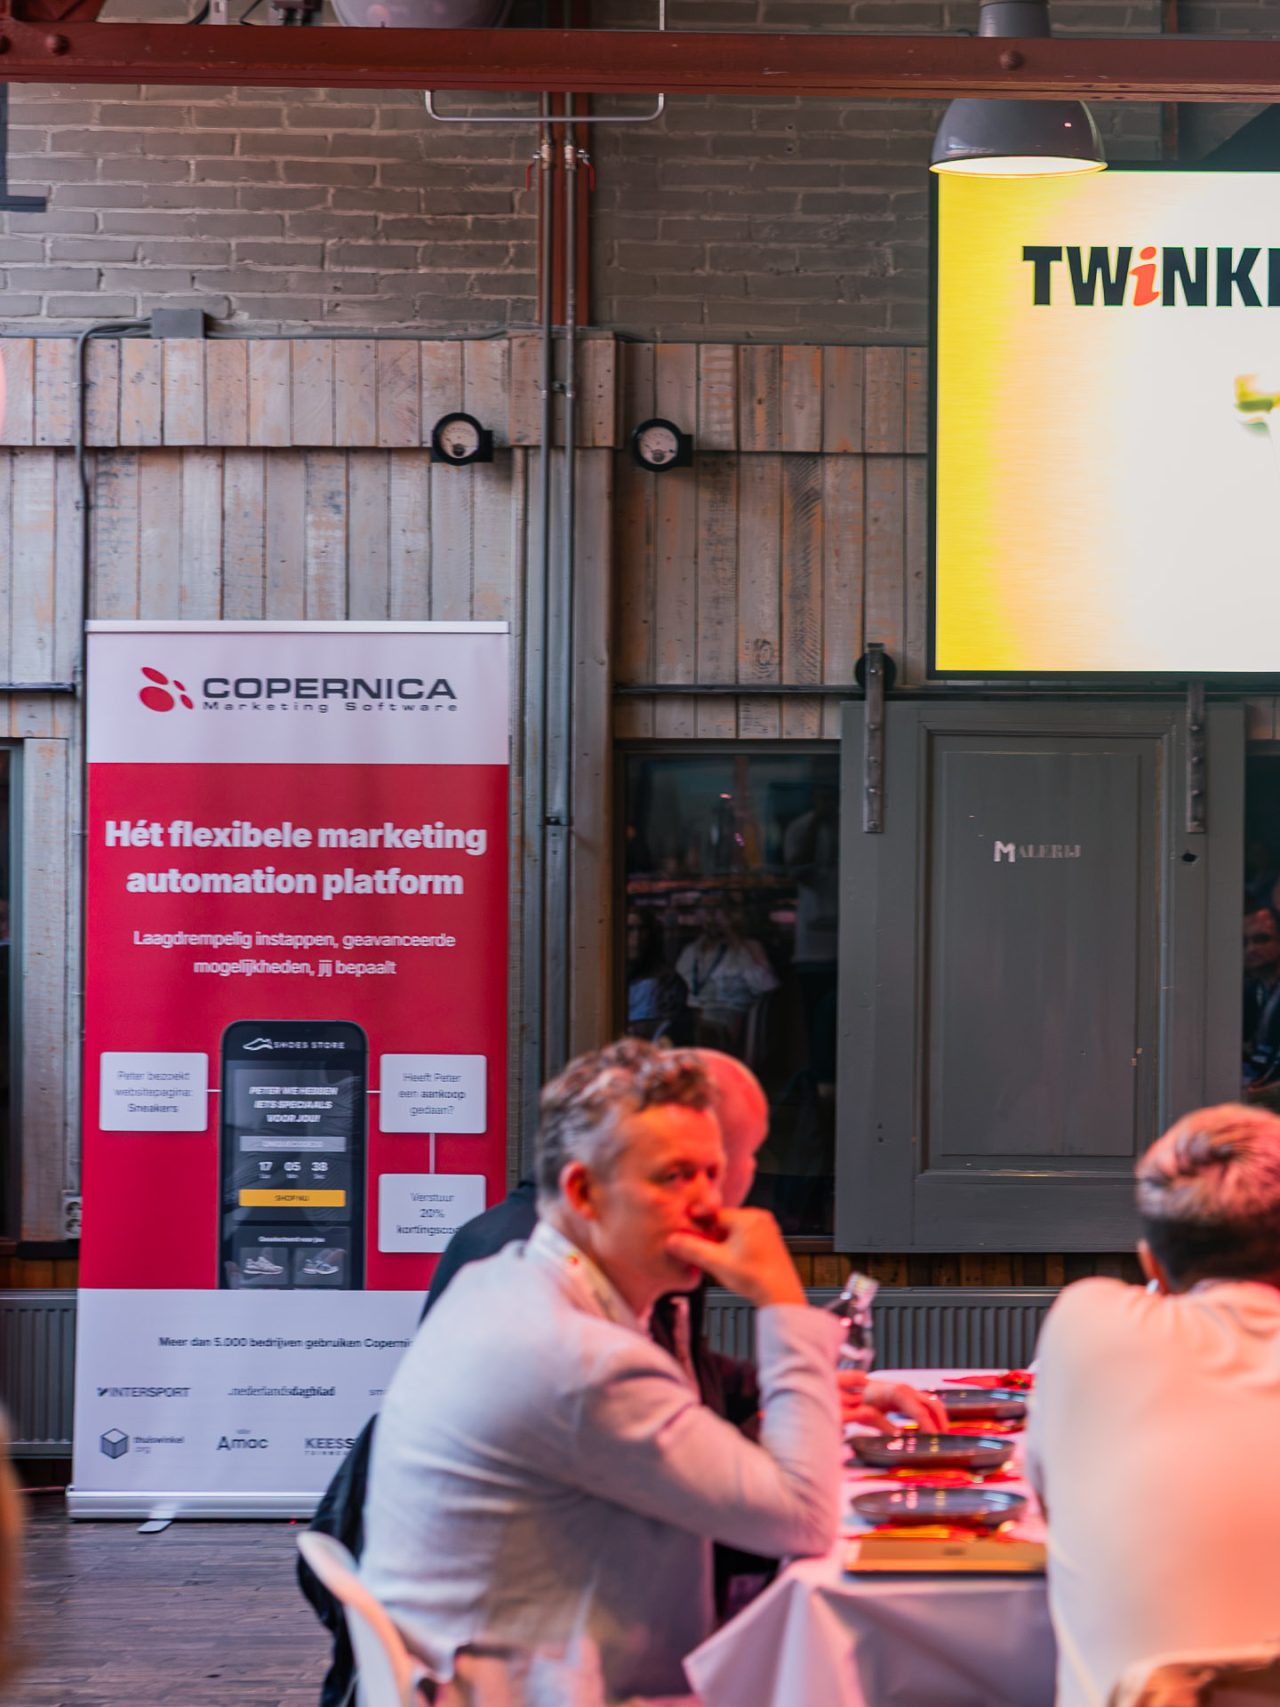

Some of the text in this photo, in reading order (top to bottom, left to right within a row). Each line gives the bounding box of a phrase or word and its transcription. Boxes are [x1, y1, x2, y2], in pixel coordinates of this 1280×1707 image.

[203, 678, 457, 700] COPERNICA
[203, 701, 457, 713] Marketing Software
[105, 820, 487, 855] Hét flexibele marketing
[126, 867, 464, 900] automation platform
[133, 931, 456, 949] Laagdrempelig instappen, geavanceerde
[193, 959, 397, 977] mogelijkheden, jij bepaalt
[273, 1042, 345, 1050] SHOES STORE
[403, 1073, 461, 1083] Heeft Peter
[127, 1103, 179, 1114] Sneakers
[258, 1161, 328, 1172] 17 05 38
[420, 1208, 446, 1218] 20%
[158, 1337, 188, 1347] Meer
[191, 1337, 211, 1347] dan
[213, 1337, 247, 1347] 5.000
[249, 1337, 302, 1350] bedrijven
[305, 1338, 362, 1349] gebruiken
